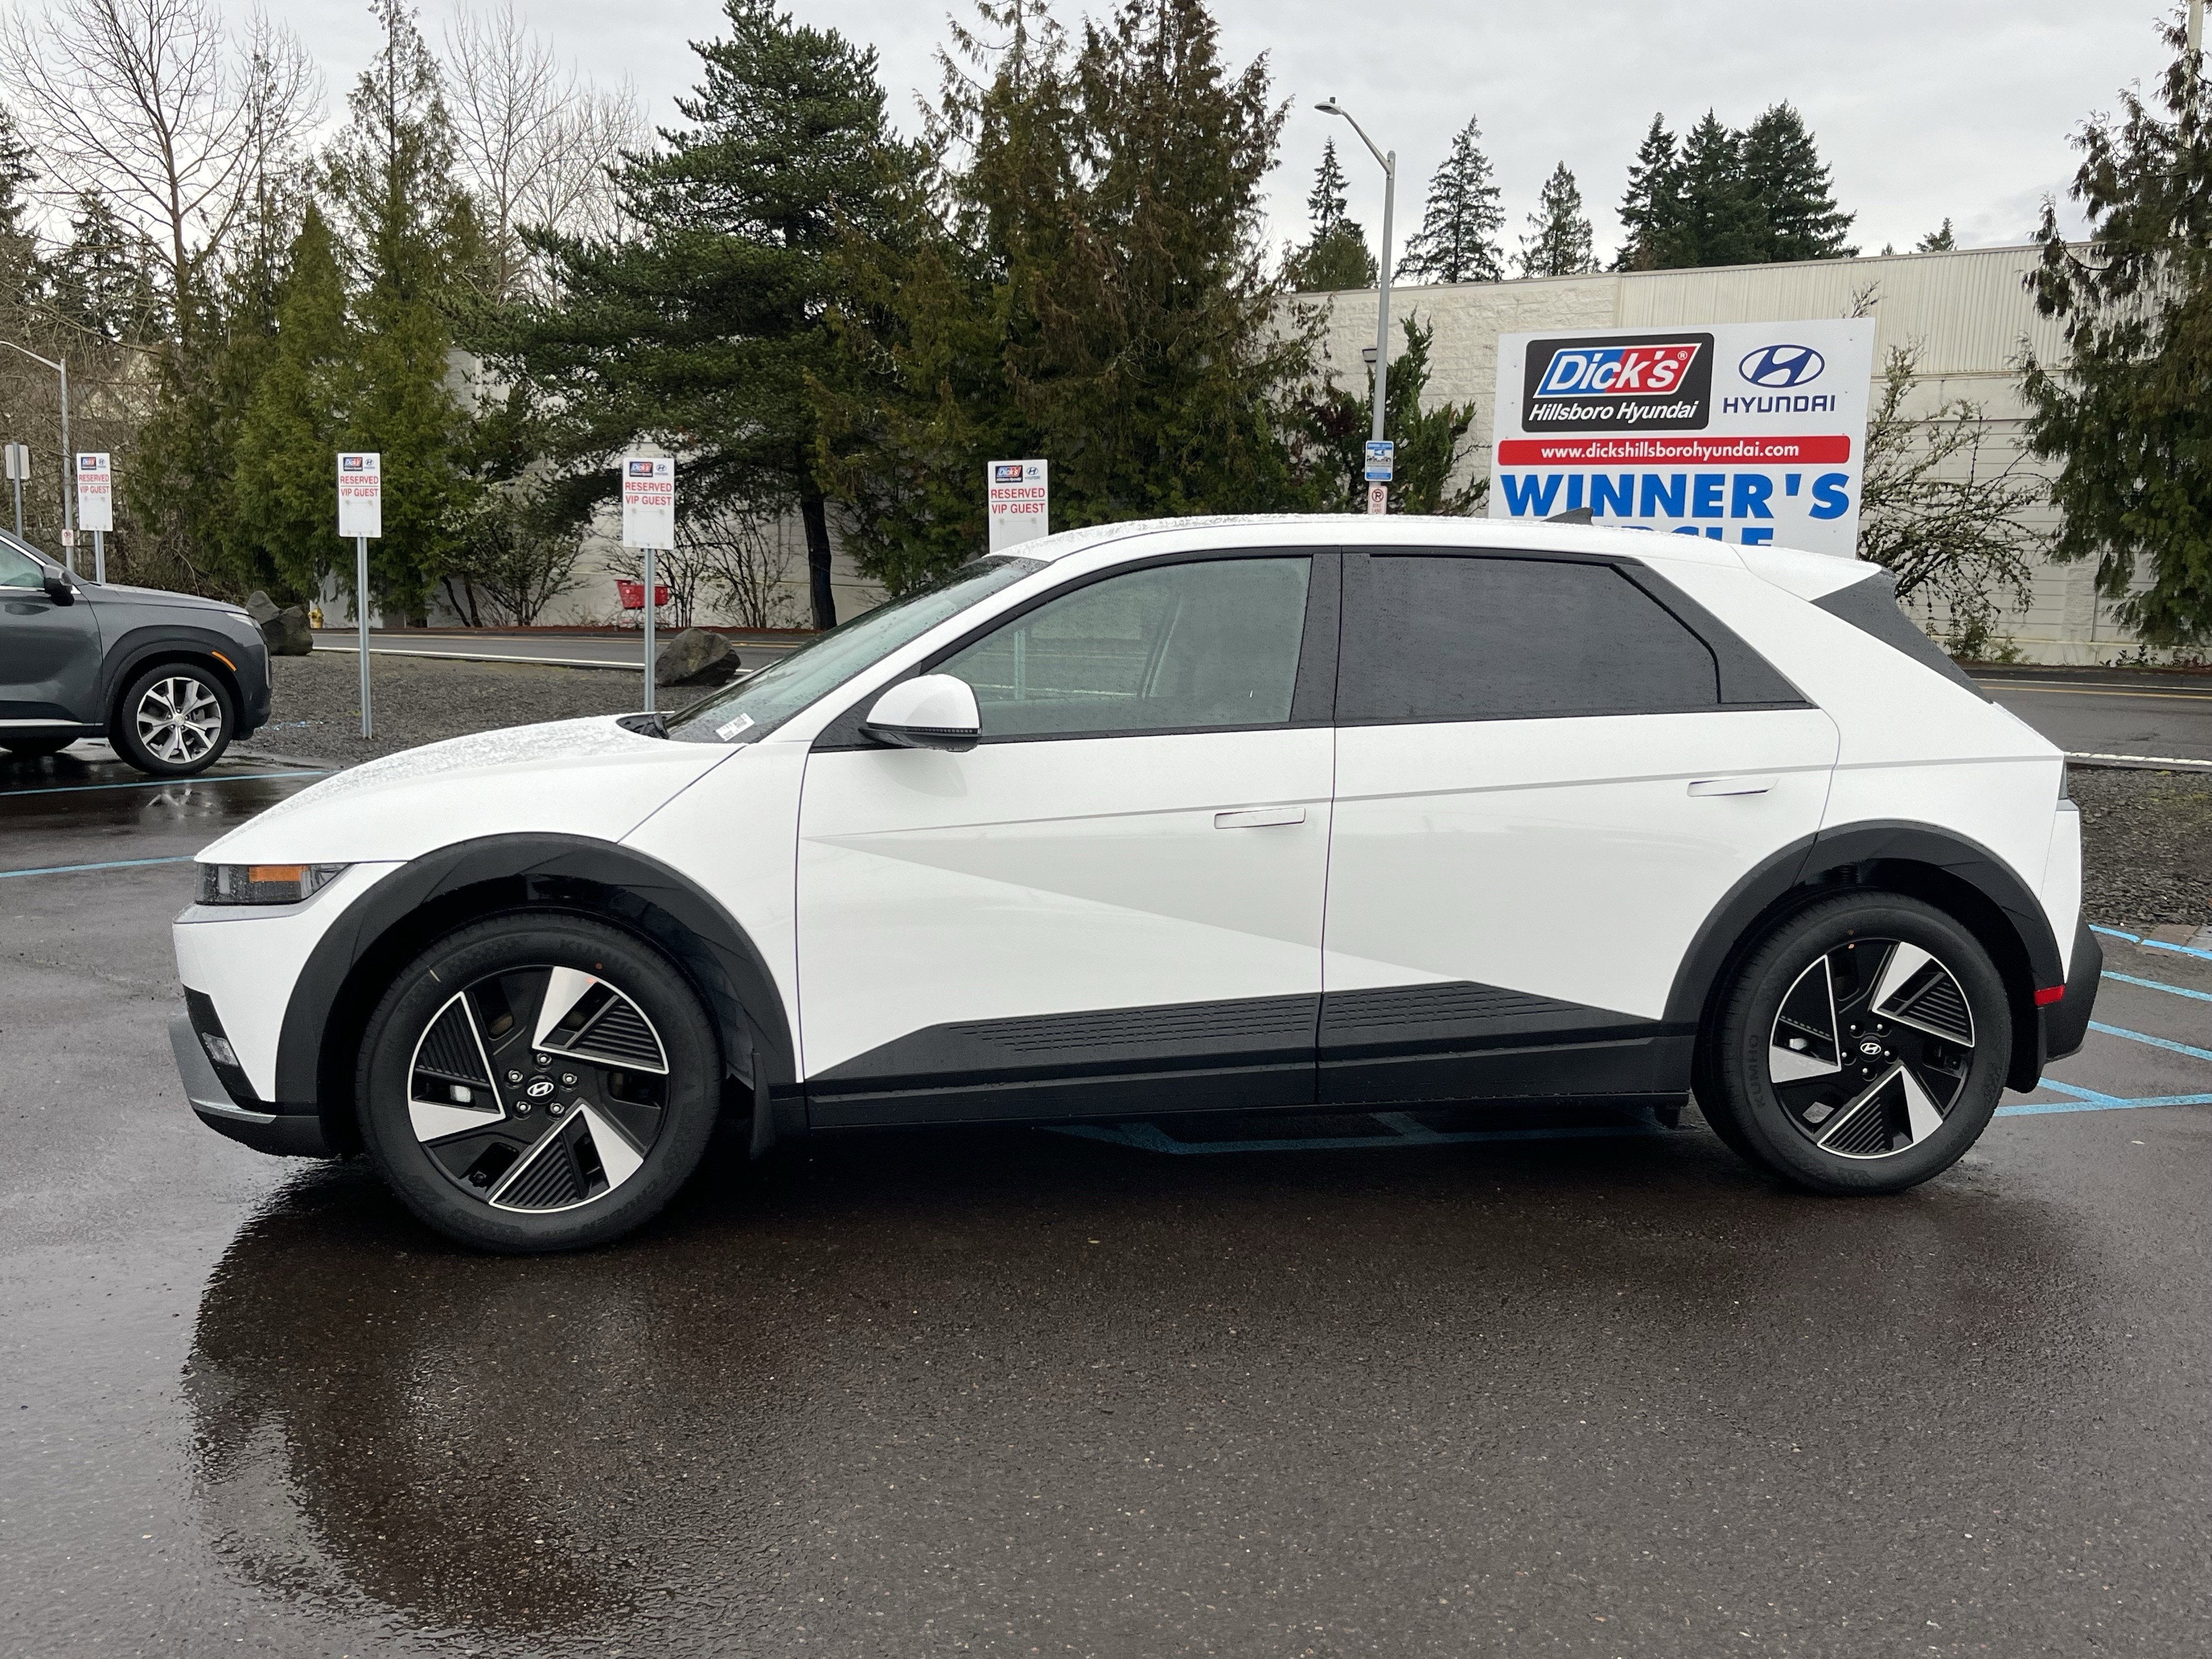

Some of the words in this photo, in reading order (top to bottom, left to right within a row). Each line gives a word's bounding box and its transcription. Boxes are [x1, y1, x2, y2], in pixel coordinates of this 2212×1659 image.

[1546, 351, 1679, 391] Dick's
[1723, 394, 1836, 414] HYUNDAI
[1528, 403, 1615, 421] Hillsboro
[1616, 400, 1700, 424] Hyundai
[1541, 440, 1799, 462] www.dickshillsborohyundai.com
[78, 473, 109, 482] RESERVED
[340, 476, 379, 484] RESERVED
[80, 485, 89, 494] VIP
[90, 485, 110, 494] GUEST
[341, 488, 352, 497] VIP
[354, 488, 379, 497] GUEST
[625, 482, 672, 492] RESERVED
[991, 488, 1045, 499] RESERVED
[1500, 472, 1850, 520] WINNER'S
[625, 495, 639, 504] VIP
[642, 495, 672, 506] GUEST
[991, 504, 1007, 514] VIP
[1011, 503, 1045, 514] GUEST
[1747, 1034, 1766, 1109] KUMHO
